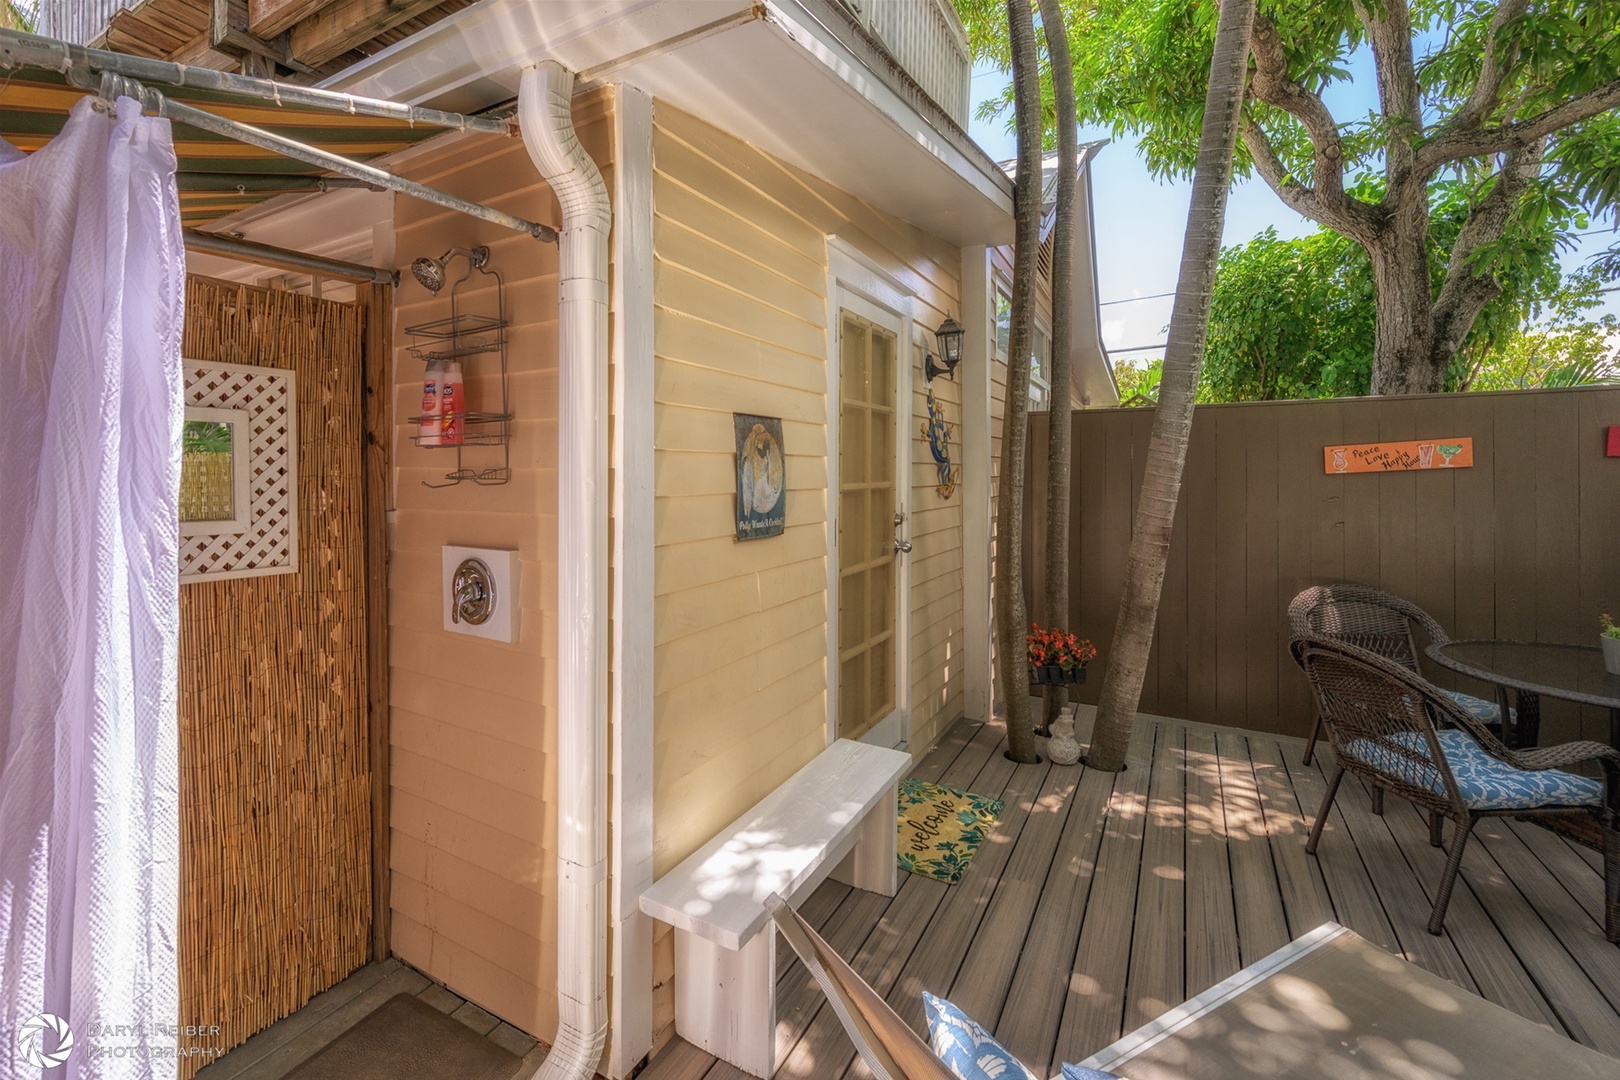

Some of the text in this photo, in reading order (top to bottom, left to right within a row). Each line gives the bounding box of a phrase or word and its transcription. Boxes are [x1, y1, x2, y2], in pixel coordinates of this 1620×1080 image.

[1352, 446, 1379, 458] Peace
[1364, 452, 1389, 465] Love
[1380, 450, 1411, 469] Happy
[1402, 454, 1420, 469] Hour
[907, 800, 955, 851] welcome
